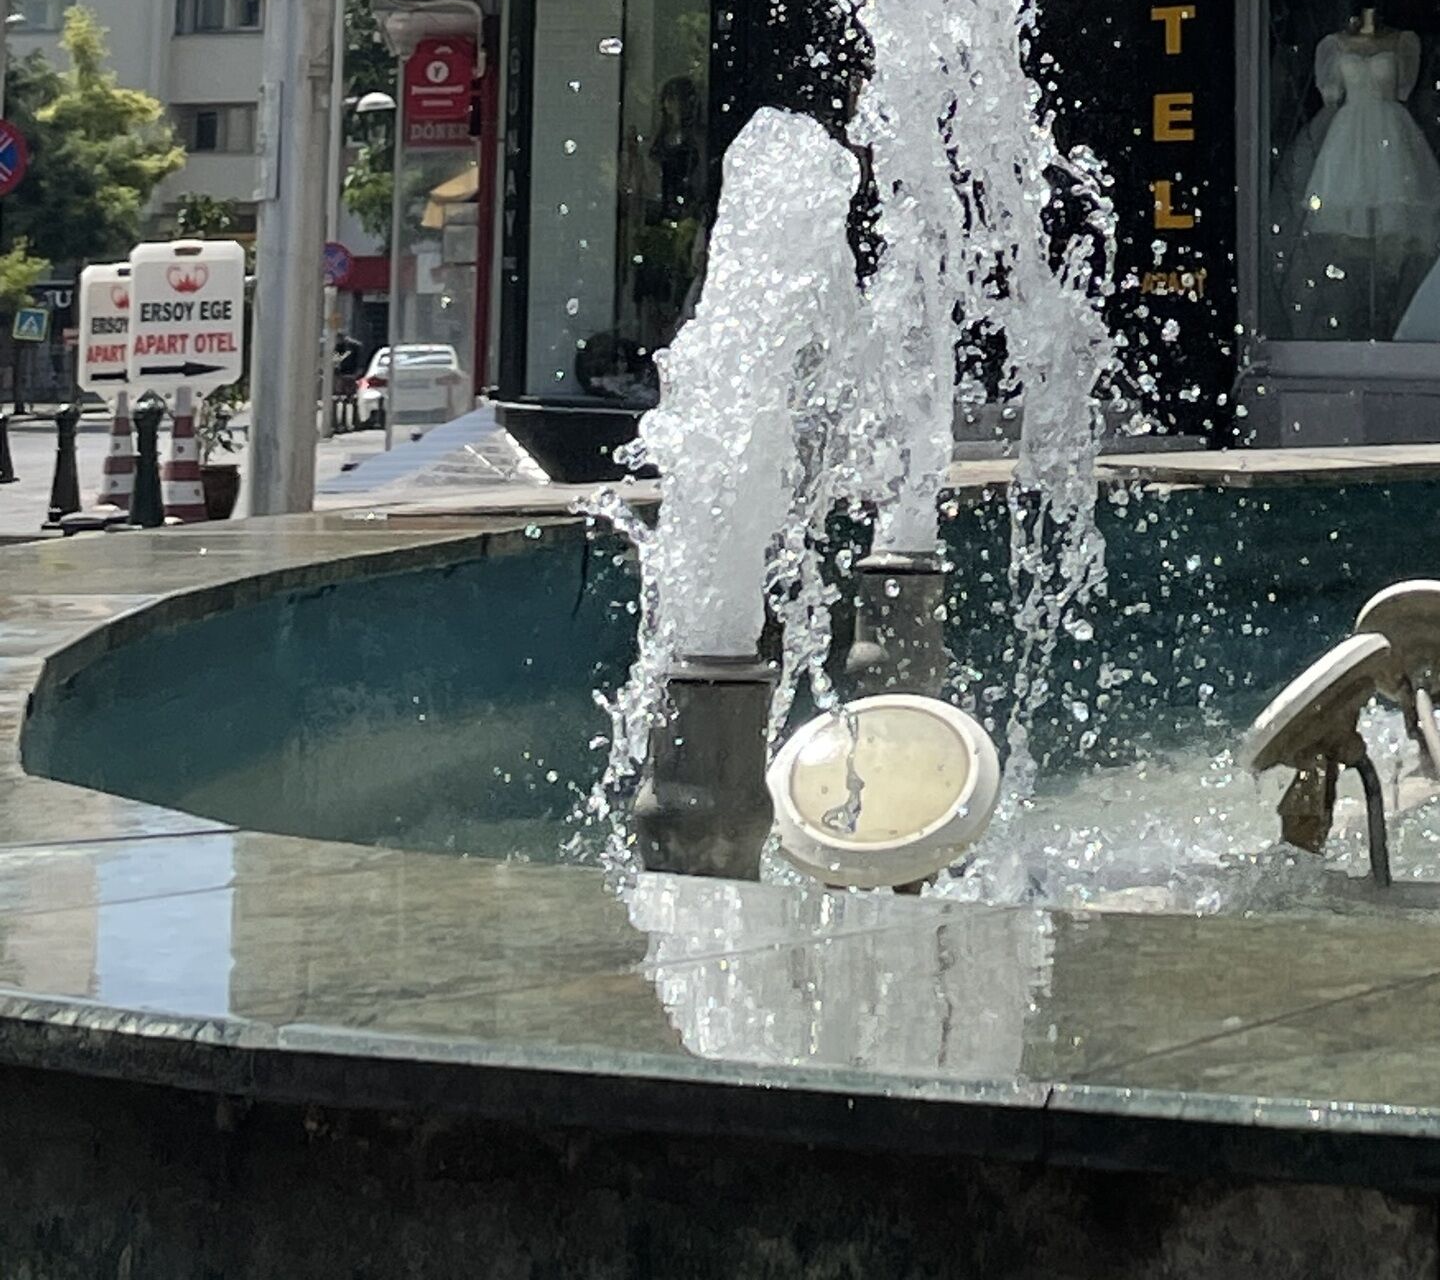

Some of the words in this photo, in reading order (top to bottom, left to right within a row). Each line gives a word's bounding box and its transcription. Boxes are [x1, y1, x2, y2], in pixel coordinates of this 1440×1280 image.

[140, 301, 195, 322] ERSOY
[200, 300, 232, 321] EGE
[86, 343, 126, 363] APART
[134, 333, 191, 356] APART
[194, 332, 238, 354] OTEL
